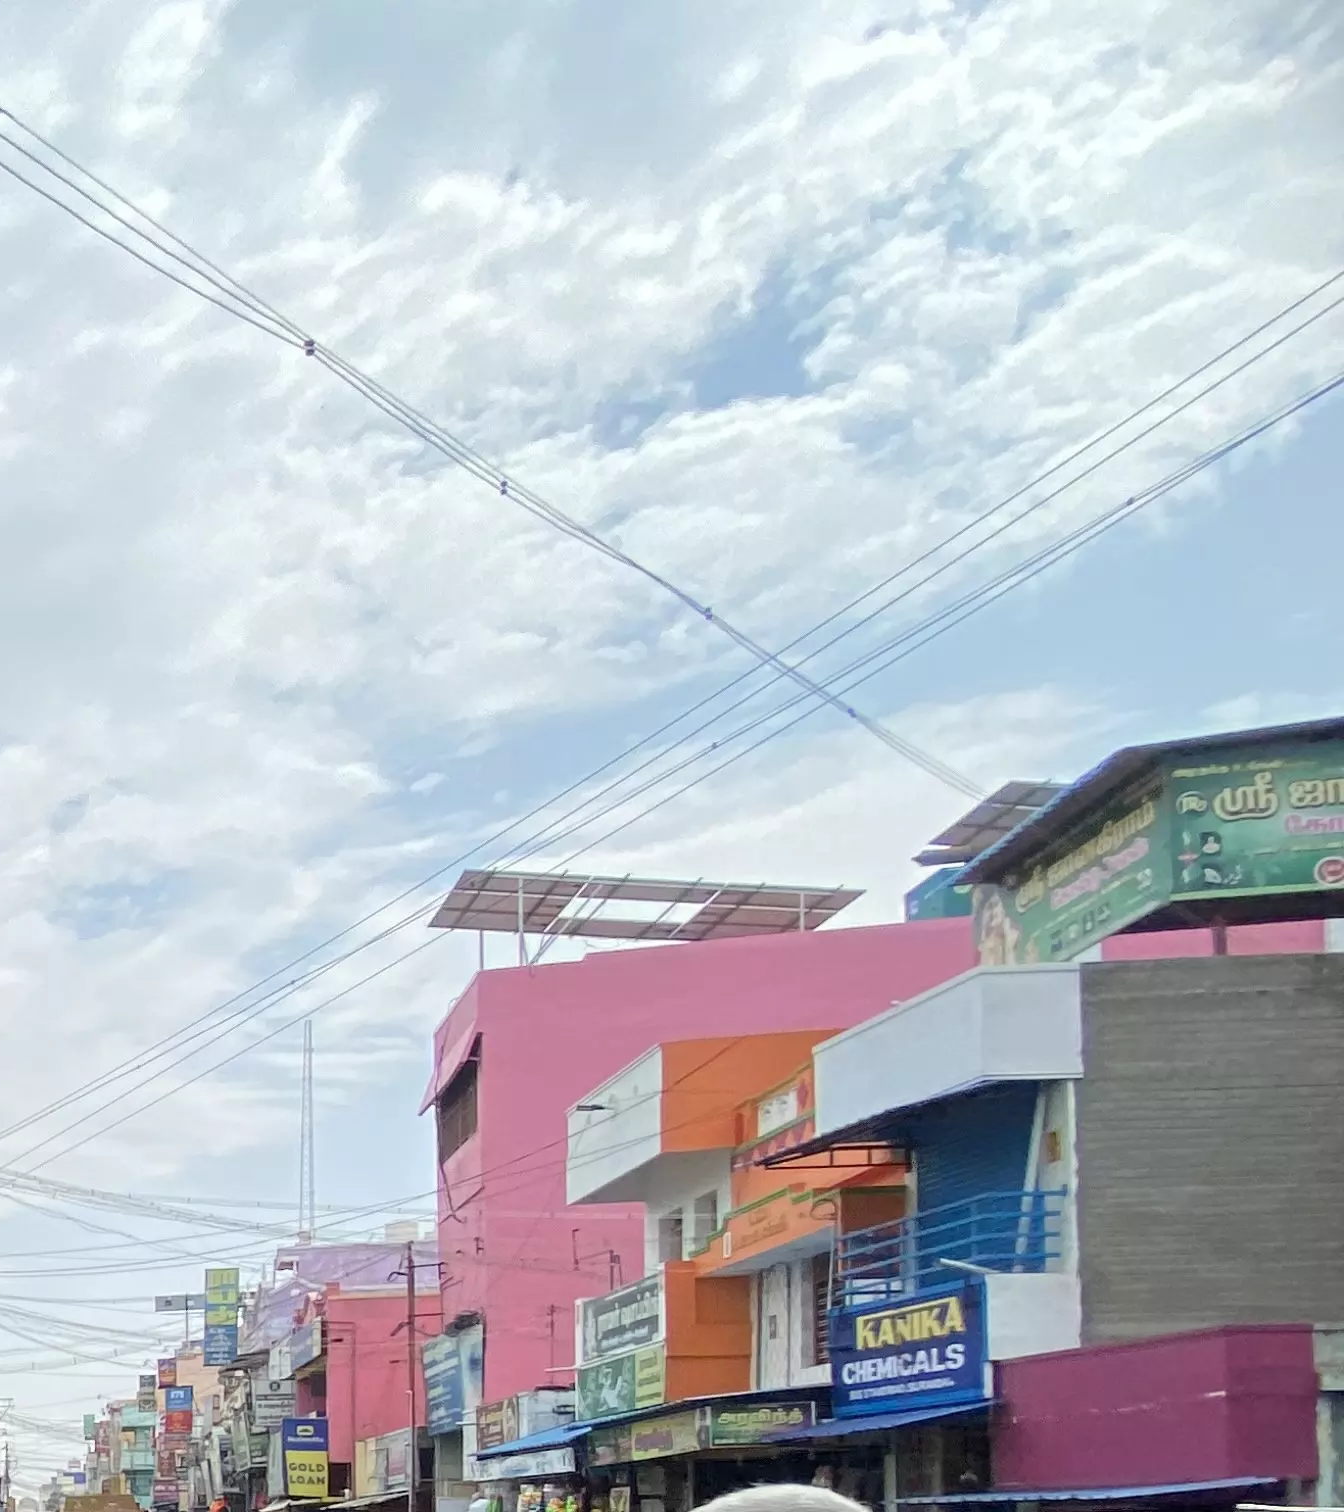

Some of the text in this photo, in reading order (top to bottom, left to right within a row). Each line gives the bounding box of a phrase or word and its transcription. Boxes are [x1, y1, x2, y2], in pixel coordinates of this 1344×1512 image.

[856, 1296, 965, 1351] KANIKA
[841, 1343, 966, 1386] CHEMICALS
[288, 1462, 325, 1472] GOLD
[288, 1474, 325, 1485] LOAN
